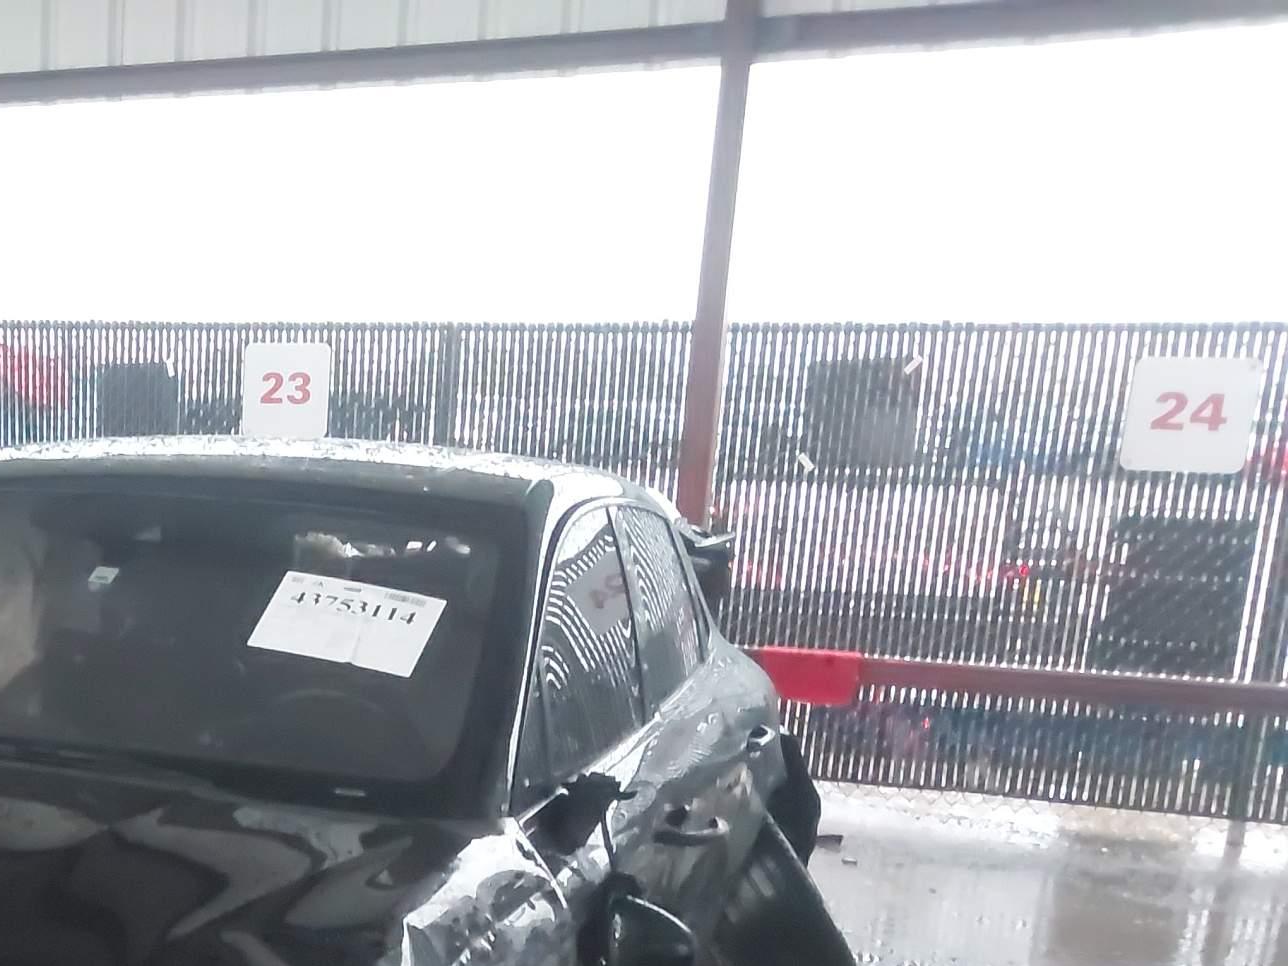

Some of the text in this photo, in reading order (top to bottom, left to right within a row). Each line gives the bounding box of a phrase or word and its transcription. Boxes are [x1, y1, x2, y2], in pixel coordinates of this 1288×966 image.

[260, 371, 312, 405] 23
[1150, 391, 1227, 432] 24
[290, 591, 417, 625] 43753114
